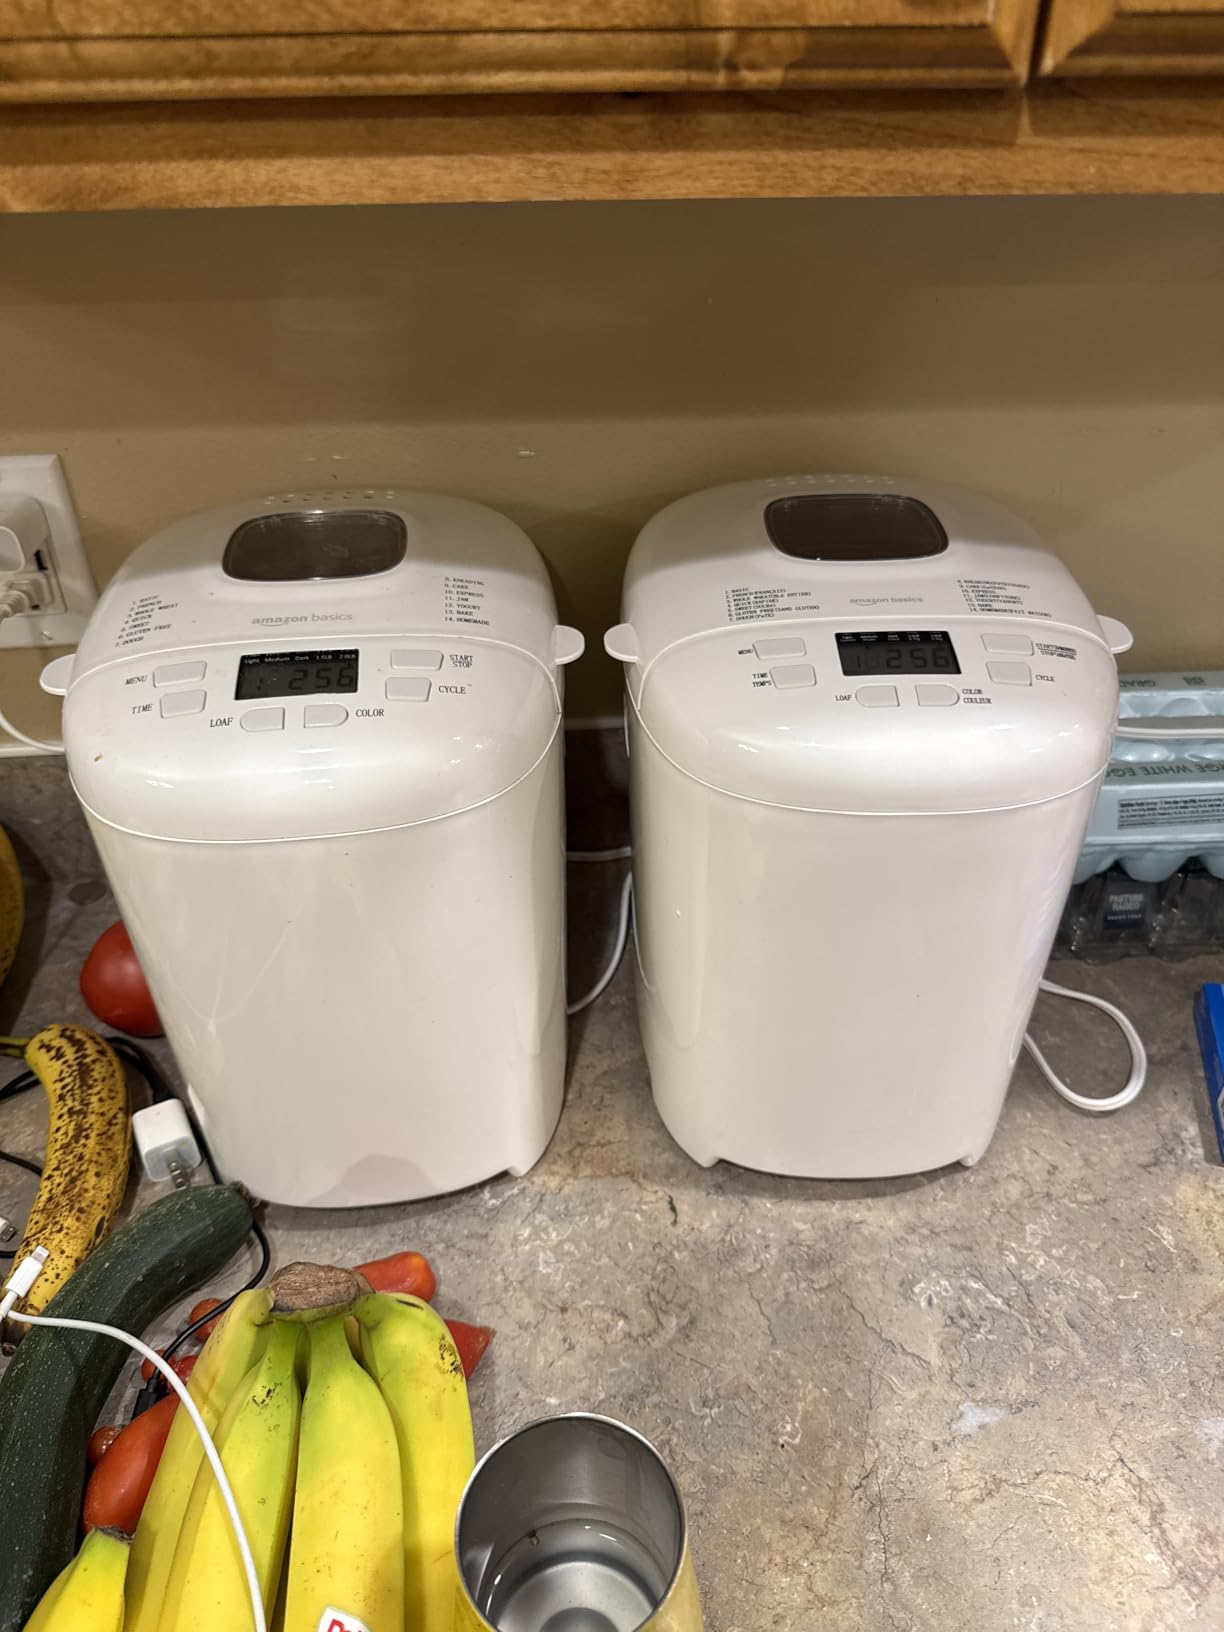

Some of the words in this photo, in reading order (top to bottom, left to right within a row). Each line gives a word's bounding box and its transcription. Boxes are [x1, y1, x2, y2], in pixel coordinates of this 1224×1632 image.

[252, 615, 308, 625] amazon
[311, 613, 353, 622] basics
[449, 654, 474, 662] START
[452, 661, 473, 669] STOP
[125, 675, 148, 686] MENU
[1119, 679, 1156, 688] GRAD
[438, 685, 467, 695] CYCLE
[835, 694, 852, 702] LOAF
[131, 703, 154, 716] TIME
[355, 708, 385, 718] COLOR
[209, 717, 234, 728] LOAF
[1143, 764, 1193, 776] WHITE
